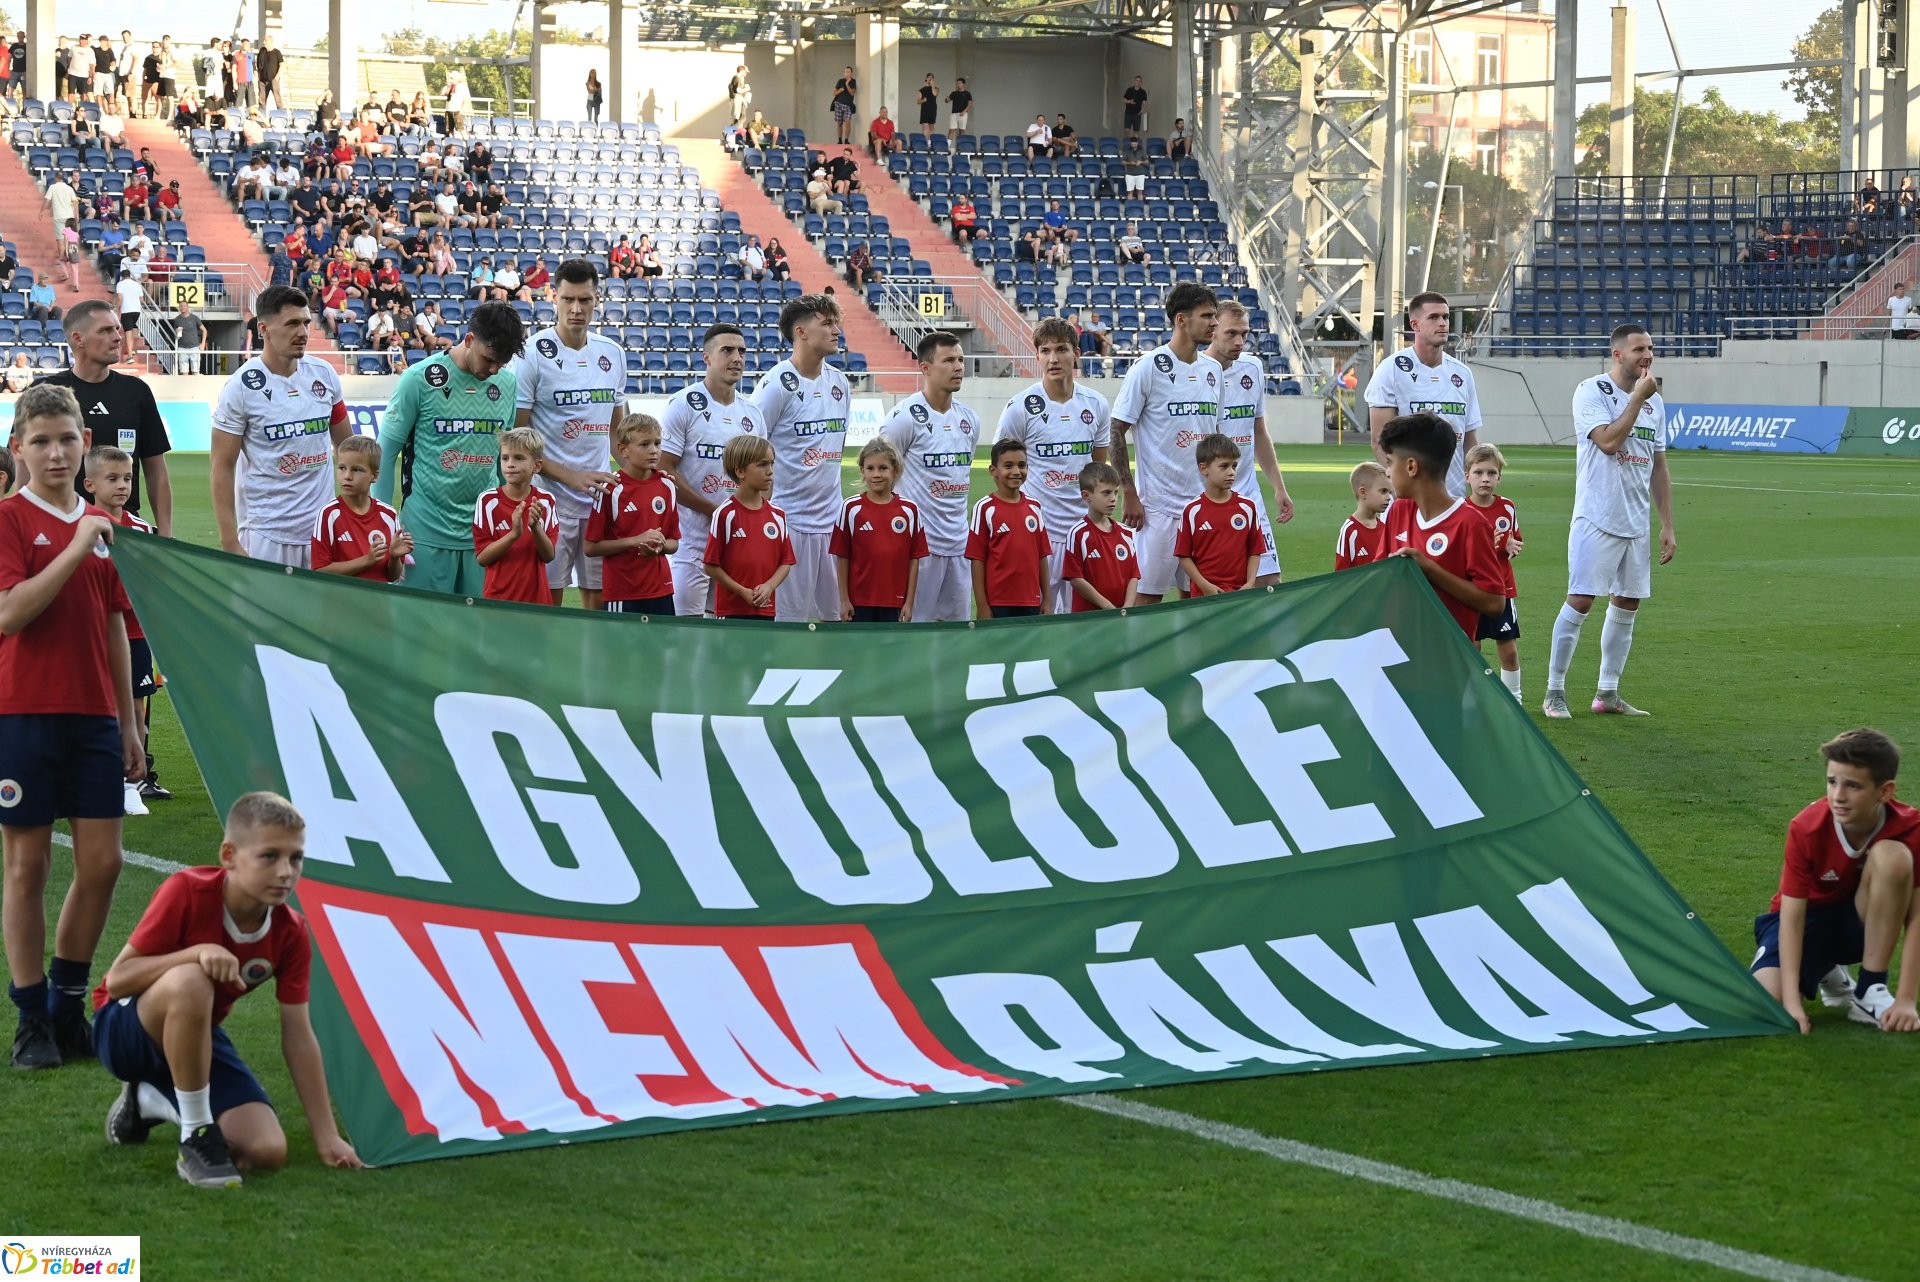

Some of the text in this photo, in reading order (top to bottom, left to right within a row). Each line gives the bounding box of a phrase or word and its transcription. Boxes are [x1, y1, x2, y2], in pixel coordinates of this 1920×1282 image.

[176, 286, 198, 304] B2
[924, 296, 939, 313] B1
[120, 431, 135, 439] FIFA
[1685, 415, 1796, 438] PRIMANET
[1263, 532, 1276, 551] 12
[254, 627, 1484, 909] A GYŰLÖLET
[322, 877, 1709, 1142] NEM PÁLYA!
